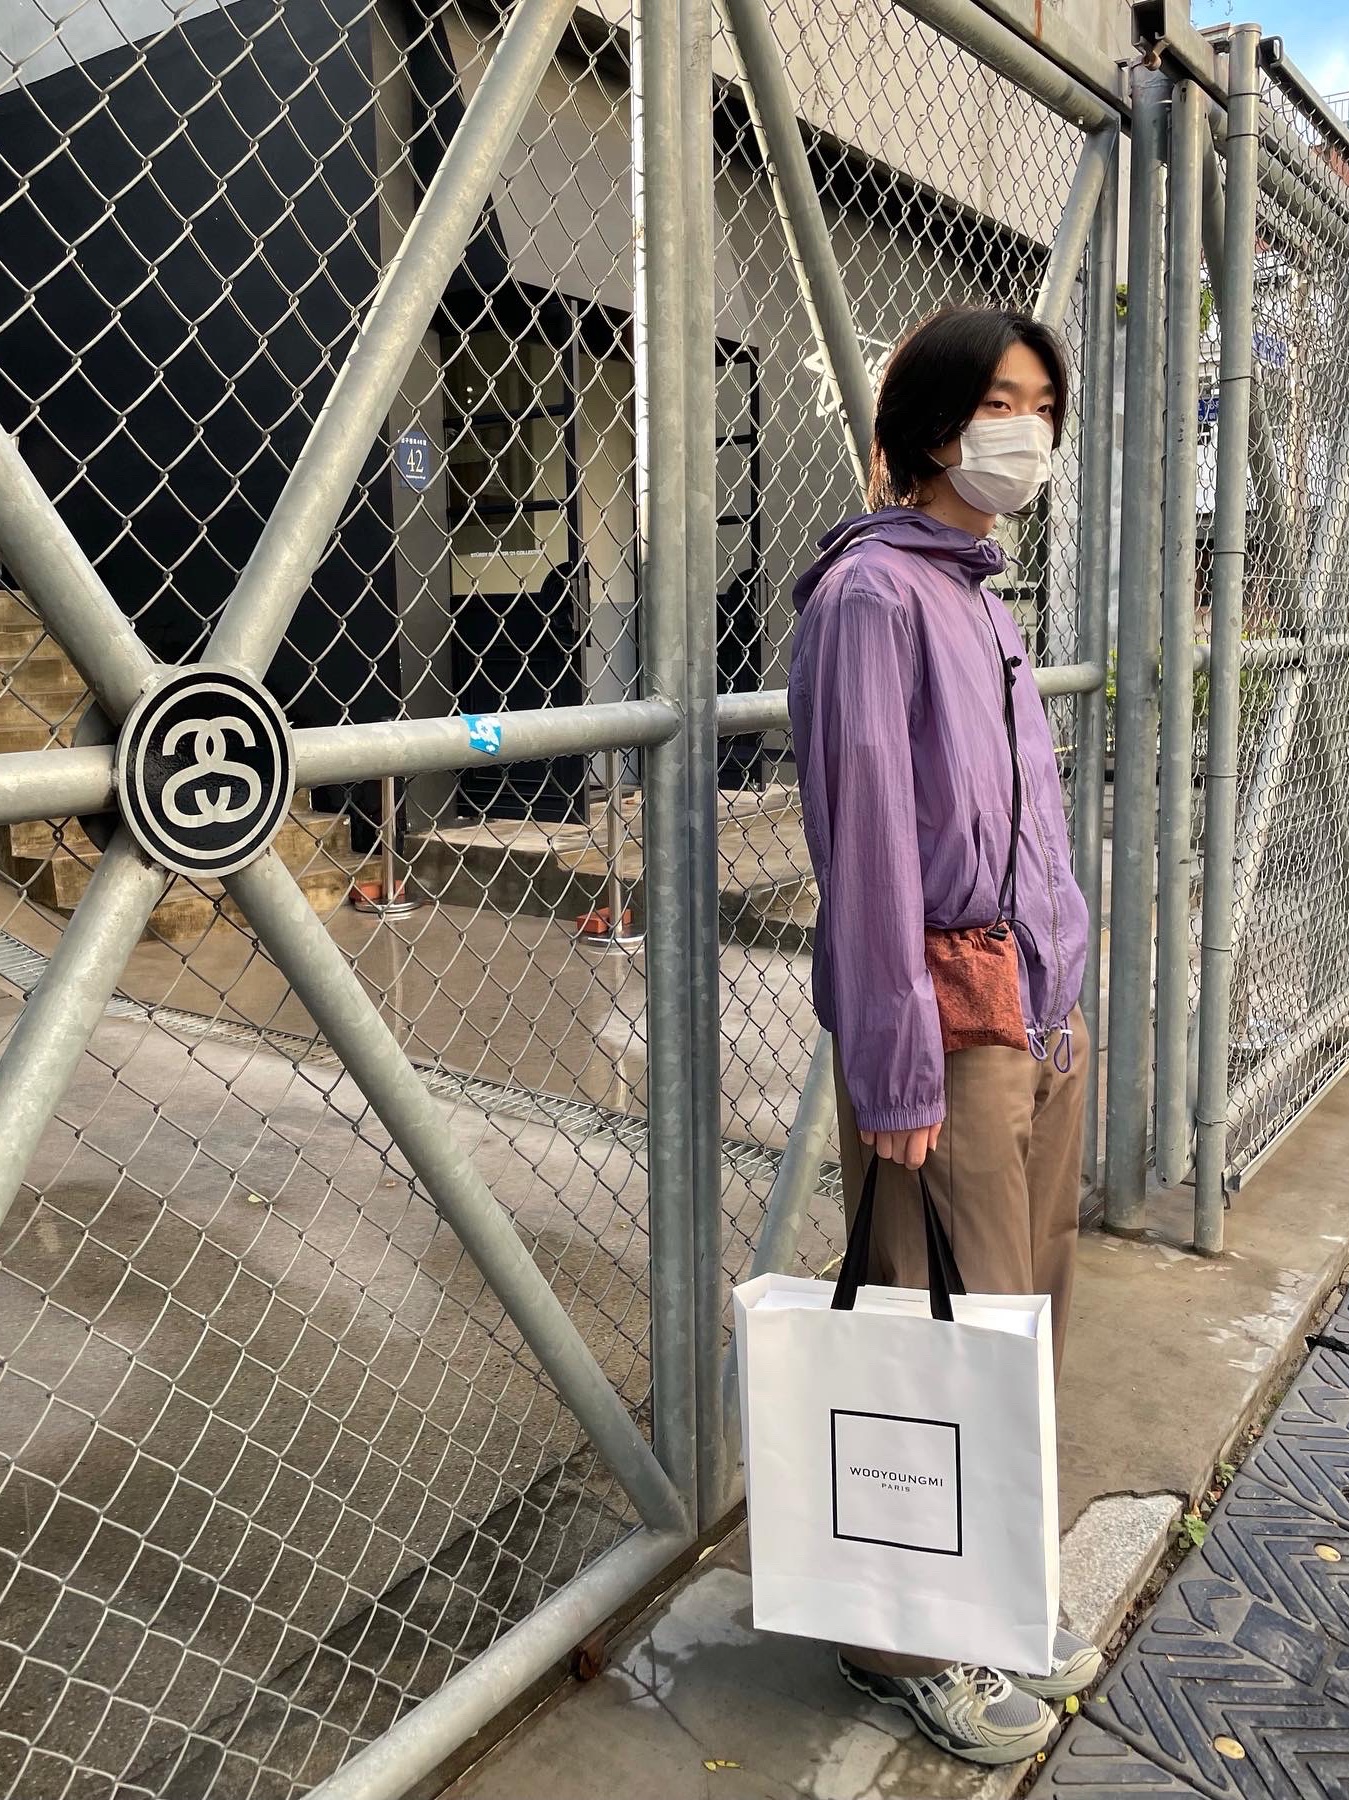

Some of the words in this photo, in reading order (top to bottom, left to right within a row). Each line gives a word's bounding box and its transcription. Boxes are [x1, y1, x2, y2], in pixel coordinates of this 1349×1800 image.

[406, 448, 424, 473] 42
[849, 1466, 943, 1487] WOOYOUNGMI
[881, 1483, 910, 1492] PARIS
